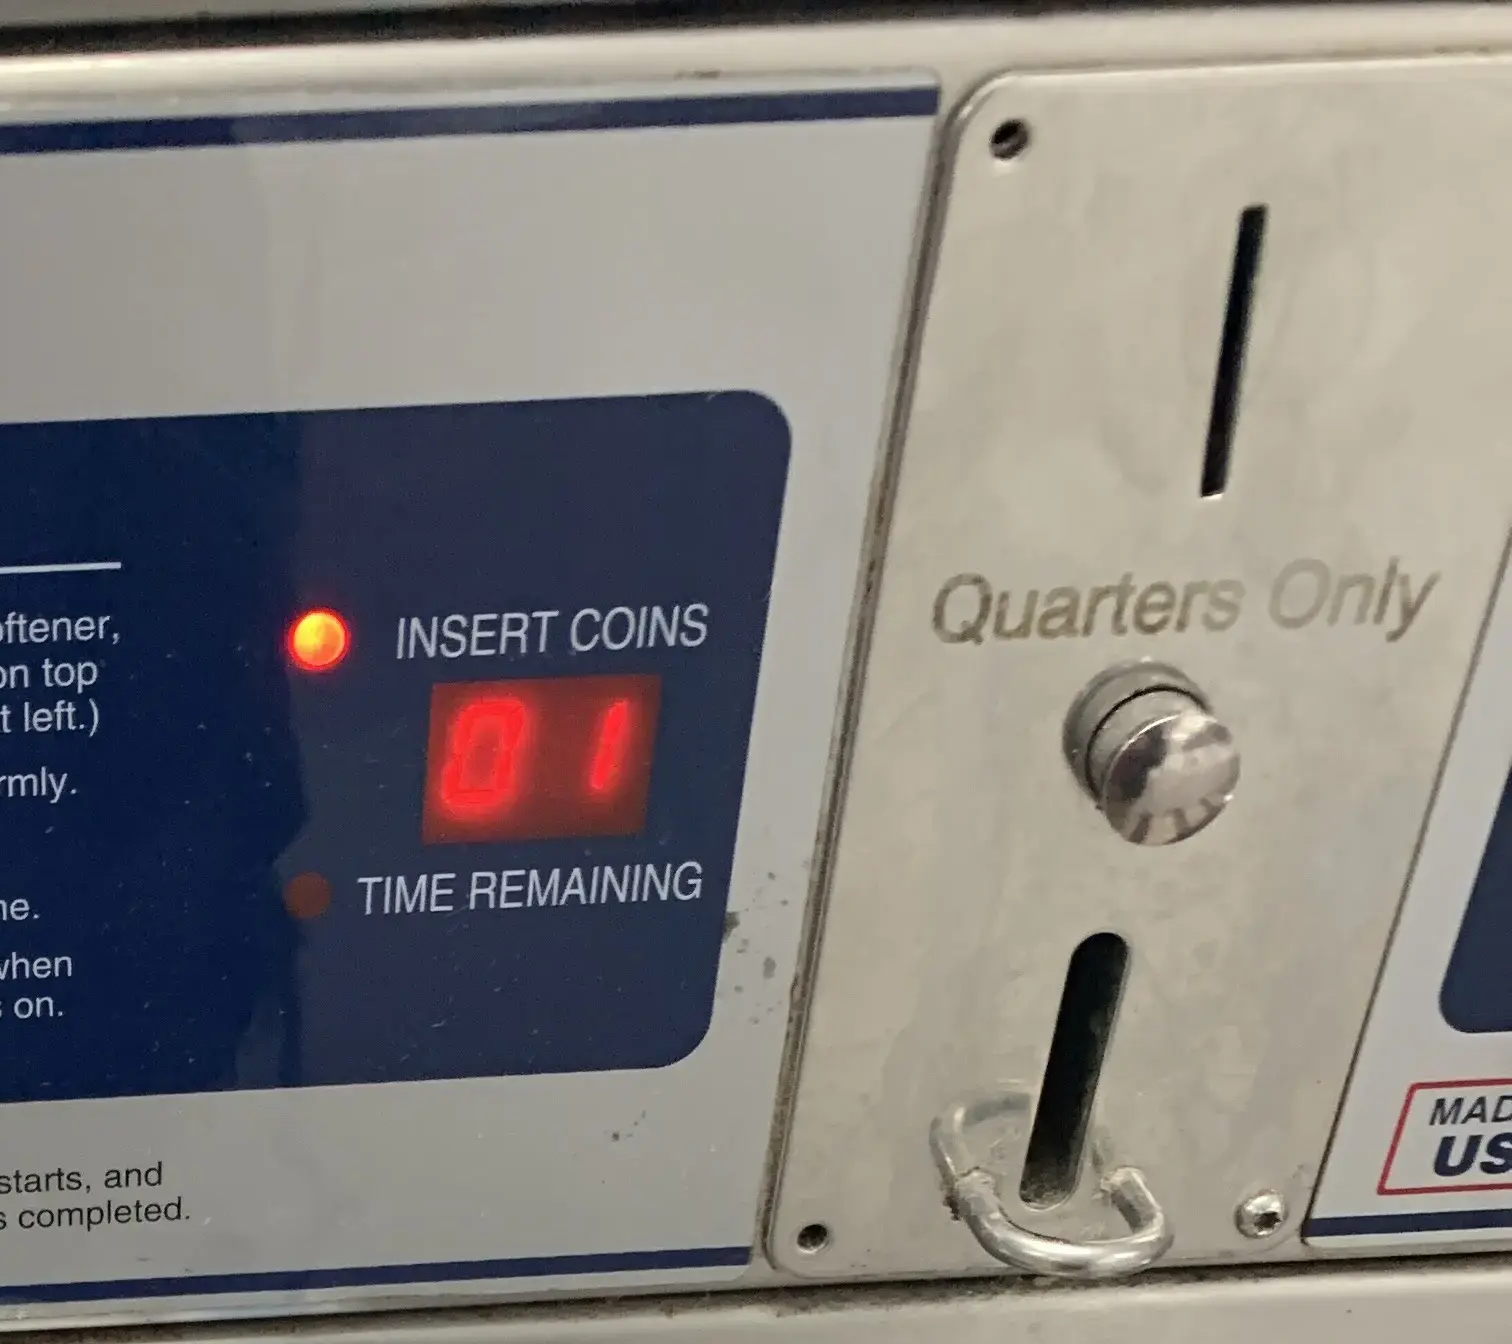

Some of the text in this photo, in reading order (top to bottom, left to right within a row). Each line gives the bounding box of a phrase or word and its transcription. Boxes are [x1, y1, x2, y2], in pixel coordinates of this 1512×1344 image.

[931, 557, 1440, 645] Quarters Only
[396, 604, 708, 660] INSERT COINS
[42, 660, 98, 693] top
[22, 700, 99, 737] left.)
[440, 698, 632, 818] 01
[357, 861, 704, 915] TIME REMAINING
[14, 993, 63, 1021] on.
[103, 1161, 164, 1189] and
[17, 1197, 191, 1233] completed.
